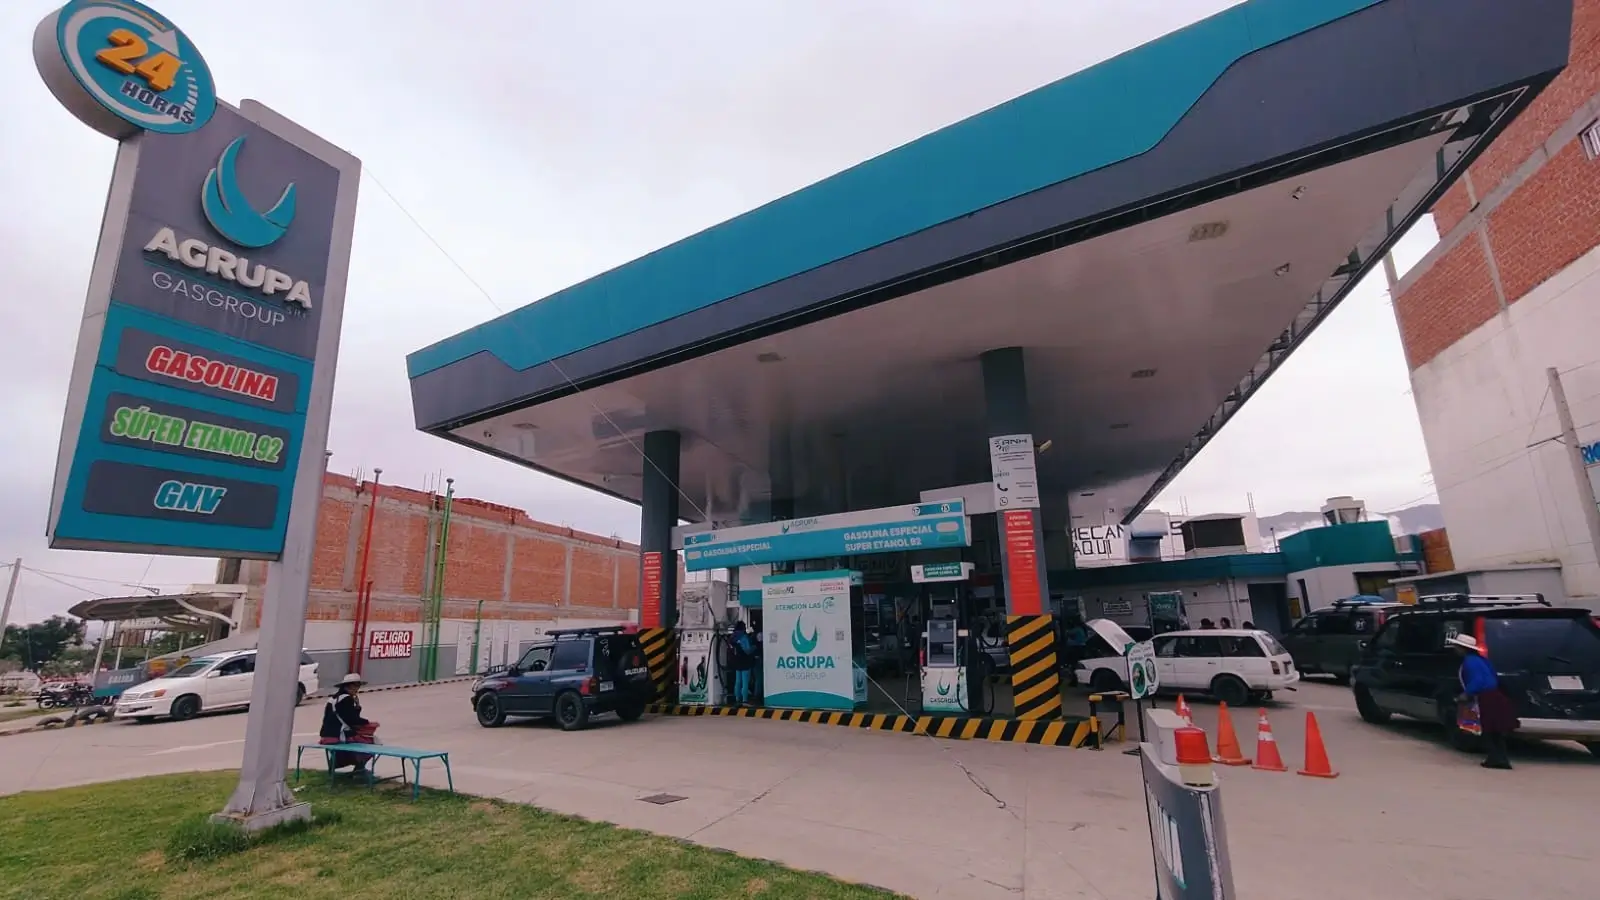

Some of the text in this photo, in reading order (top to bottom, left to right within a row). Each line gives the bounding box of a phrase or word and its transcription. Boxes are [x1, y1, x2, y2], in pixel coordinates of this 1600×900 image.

[95, 28, 184, 92] 24
[120, 80, 197, 125] HORAS
[143, 226, 313, 309] AGRUPA
[152, 271, 285, 326] GASGROUP
[146, 345, 279, 401] GASOLINA
[111, 406, 284, 463] SÚPER ETANOL 92
[154, 480, 226, 514] GNV
[703, 543, 772, 557] GASOLINA ESPECIAL
[843, 525, 933, 541] GASOLINA ESPECIAL
[369, 644, 411, 658] INFLAMABLE
[373, 631, 410, 643] PELIGRO
[776, 655, 835, 669] AGRUPA
[785, 671, 826, 680] GASGROUP
